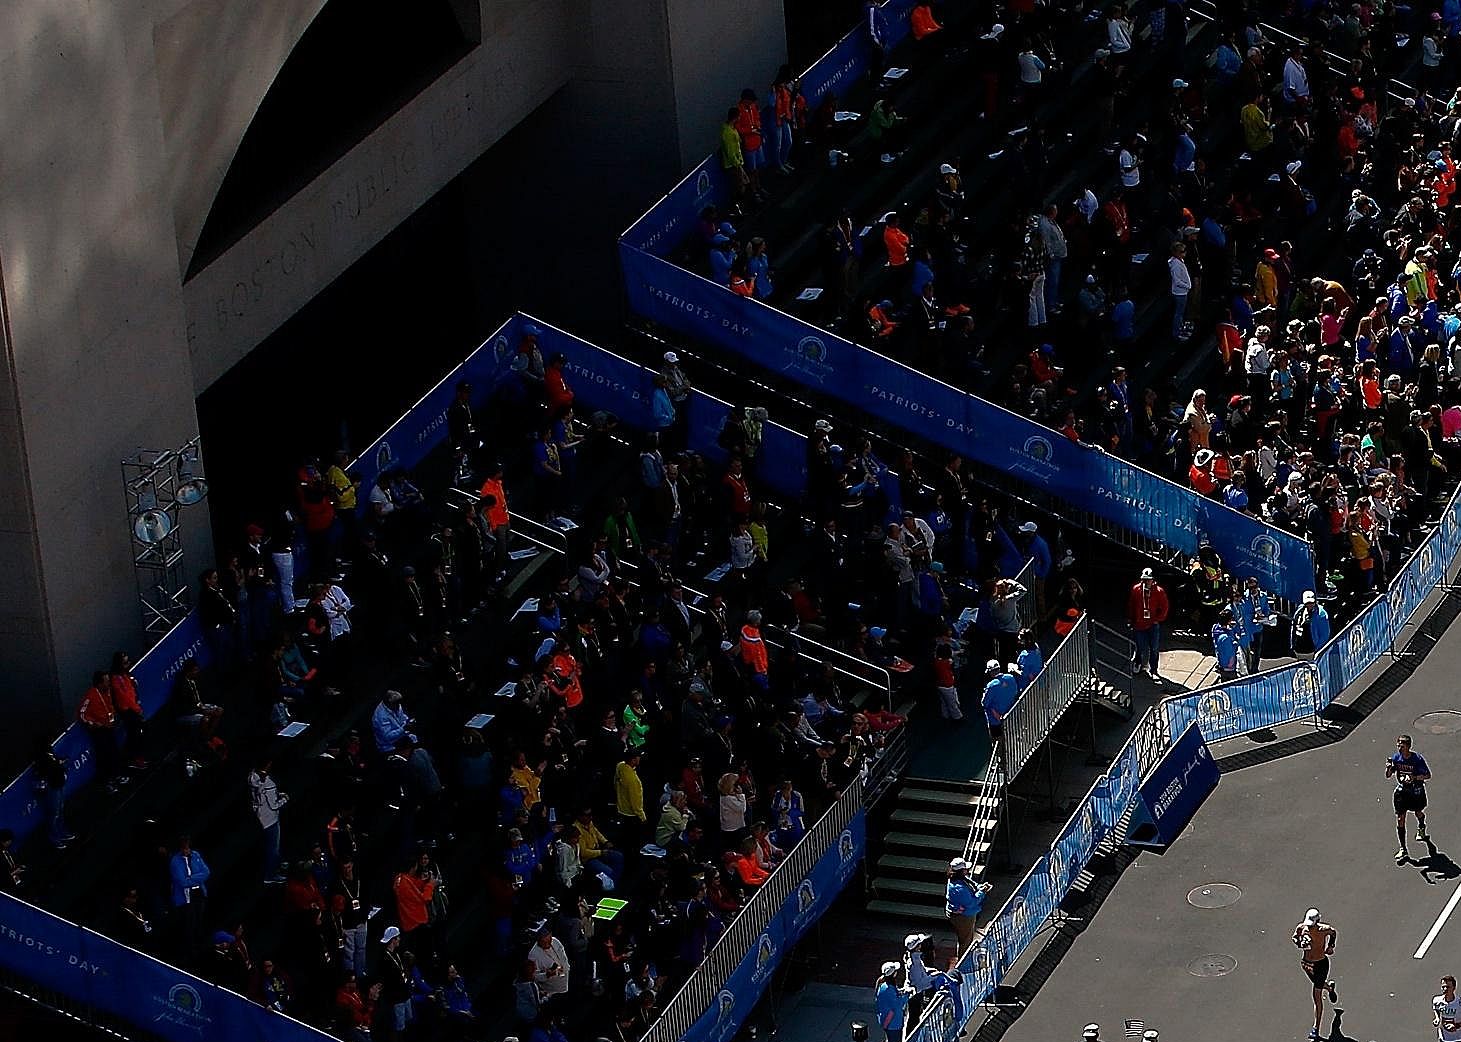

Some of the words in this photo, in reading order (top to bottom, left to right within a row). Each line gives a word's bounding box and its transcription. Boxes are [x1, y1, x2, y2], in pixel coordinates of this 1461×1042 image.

[721, 317, 750, 338] DAY
[561, 358, 627, 392] ATRIOTS'
[870, 385, 941, 420] PATRIOTS'
[946, 416, 975, 436] DAY
[1096, 486, 1169, 519] PATRIOTS'
[67, 953, 101, 976] DAY
